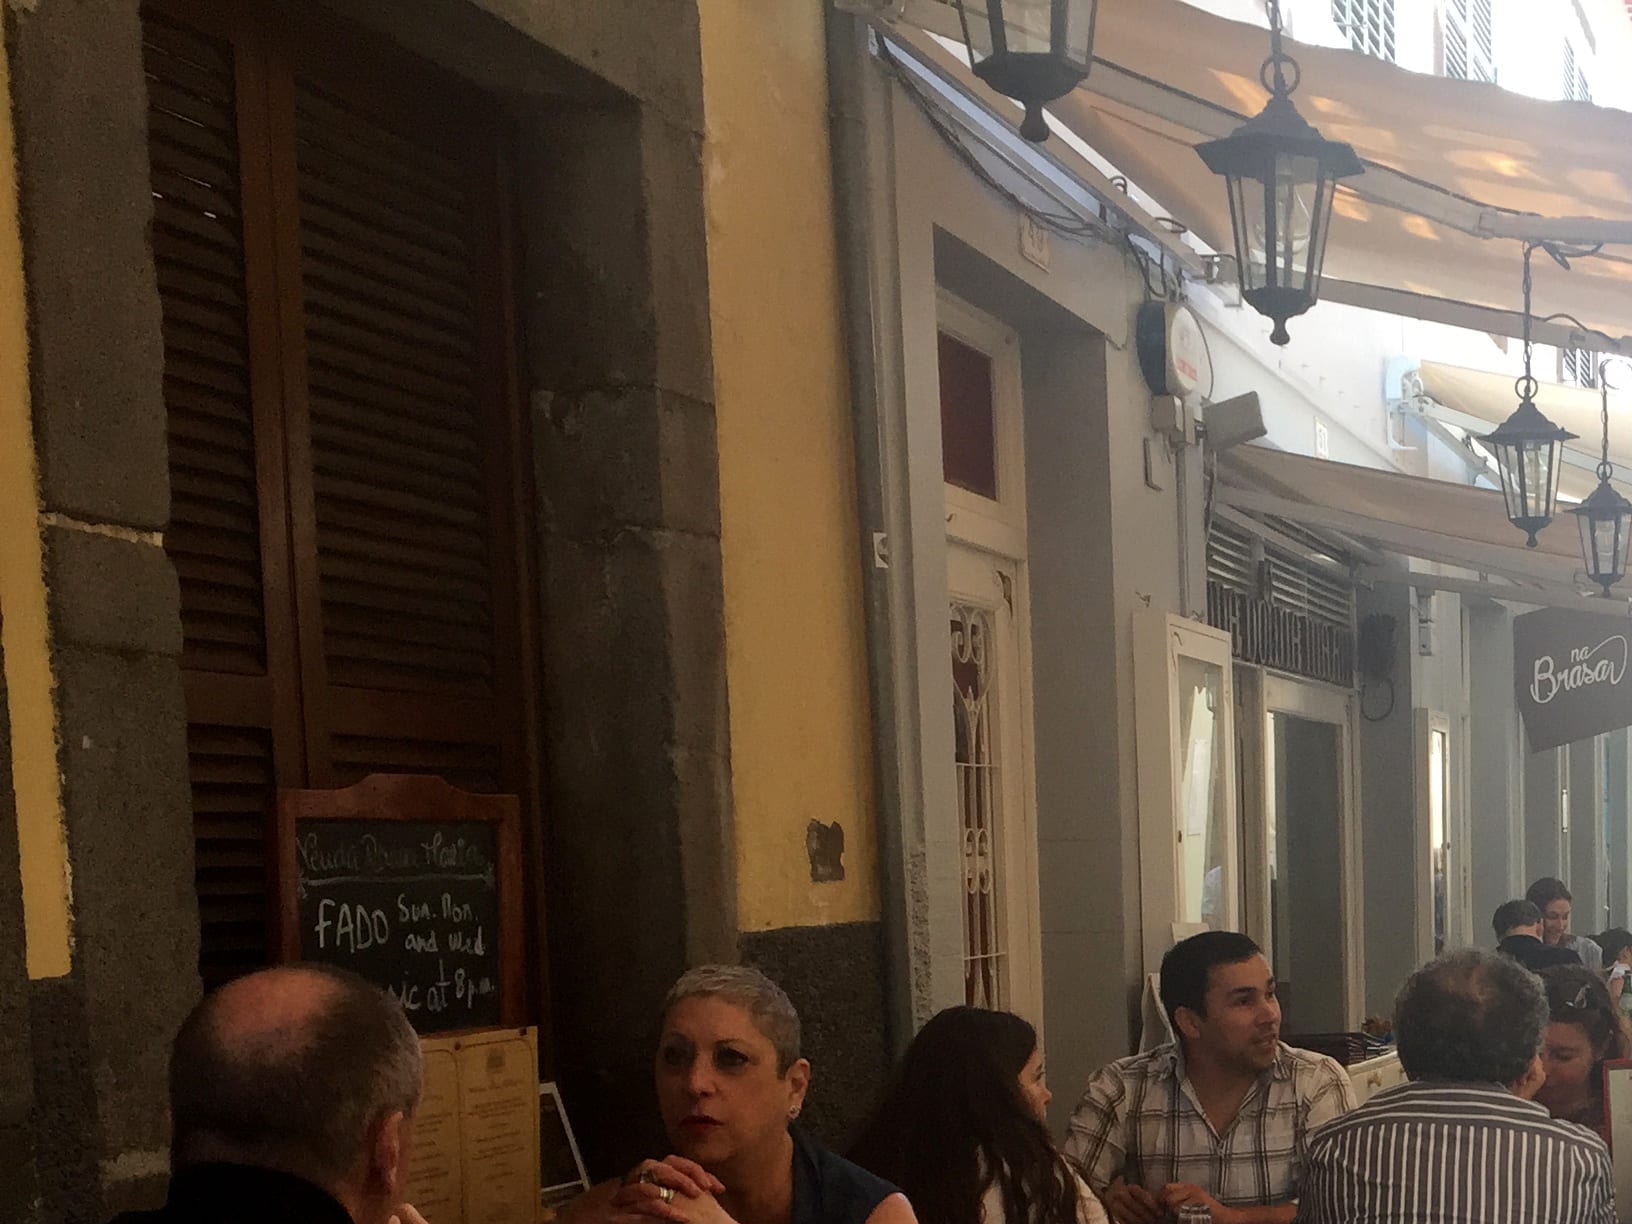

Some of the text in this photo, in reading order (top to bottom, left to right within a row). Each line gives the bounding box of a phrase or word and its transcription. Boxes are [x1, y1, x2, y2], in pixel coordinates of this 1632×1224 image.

[1529, 655, 1617, 704] Brasa
[314, 898, 389, 955] FADO
[404, 929, 439, 953] and
[426, 959, 452, 1012] at
